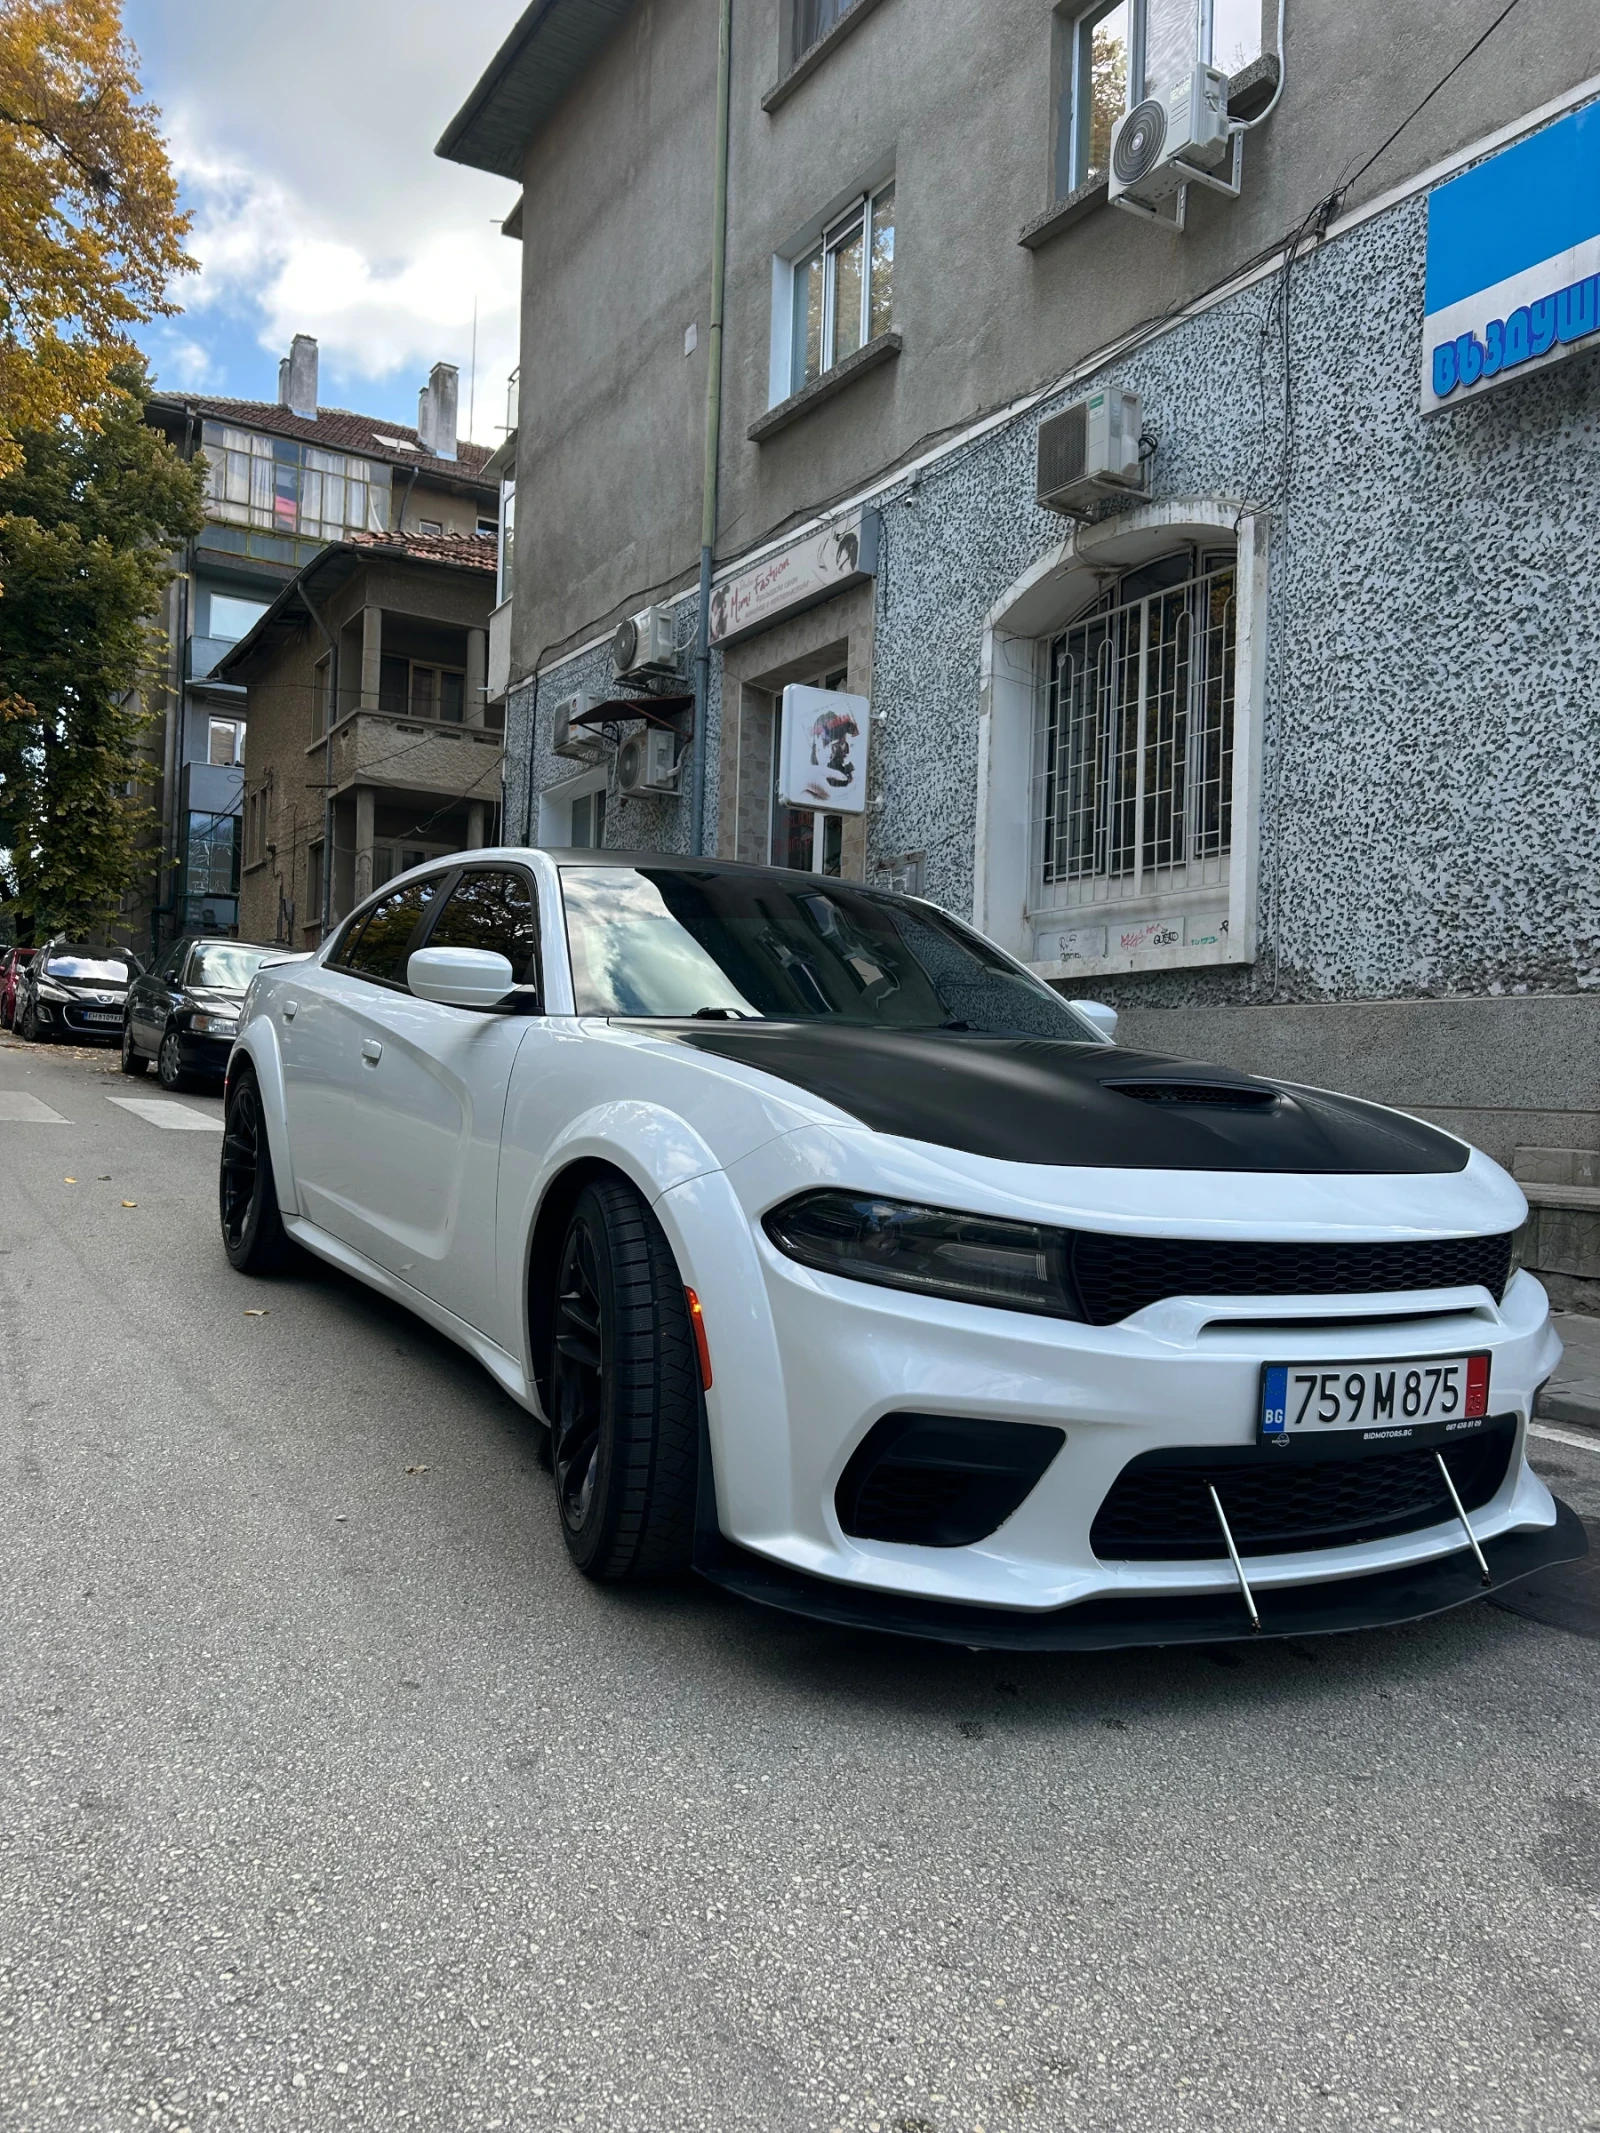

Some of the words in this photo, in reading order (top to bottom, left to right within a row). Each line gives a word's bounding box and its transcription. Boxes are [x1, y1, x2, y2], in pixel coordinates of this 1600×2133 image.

[1432, 272, 1600, 398] ВЪЗДУШ
[731, 587, 751, 623] Mimi
[753, 558, 791, 595] Fashion
[1264, 1408, 1284, 1424] BG
[1363, 1429, 1413, 1440] BIDMOTORS.BG
